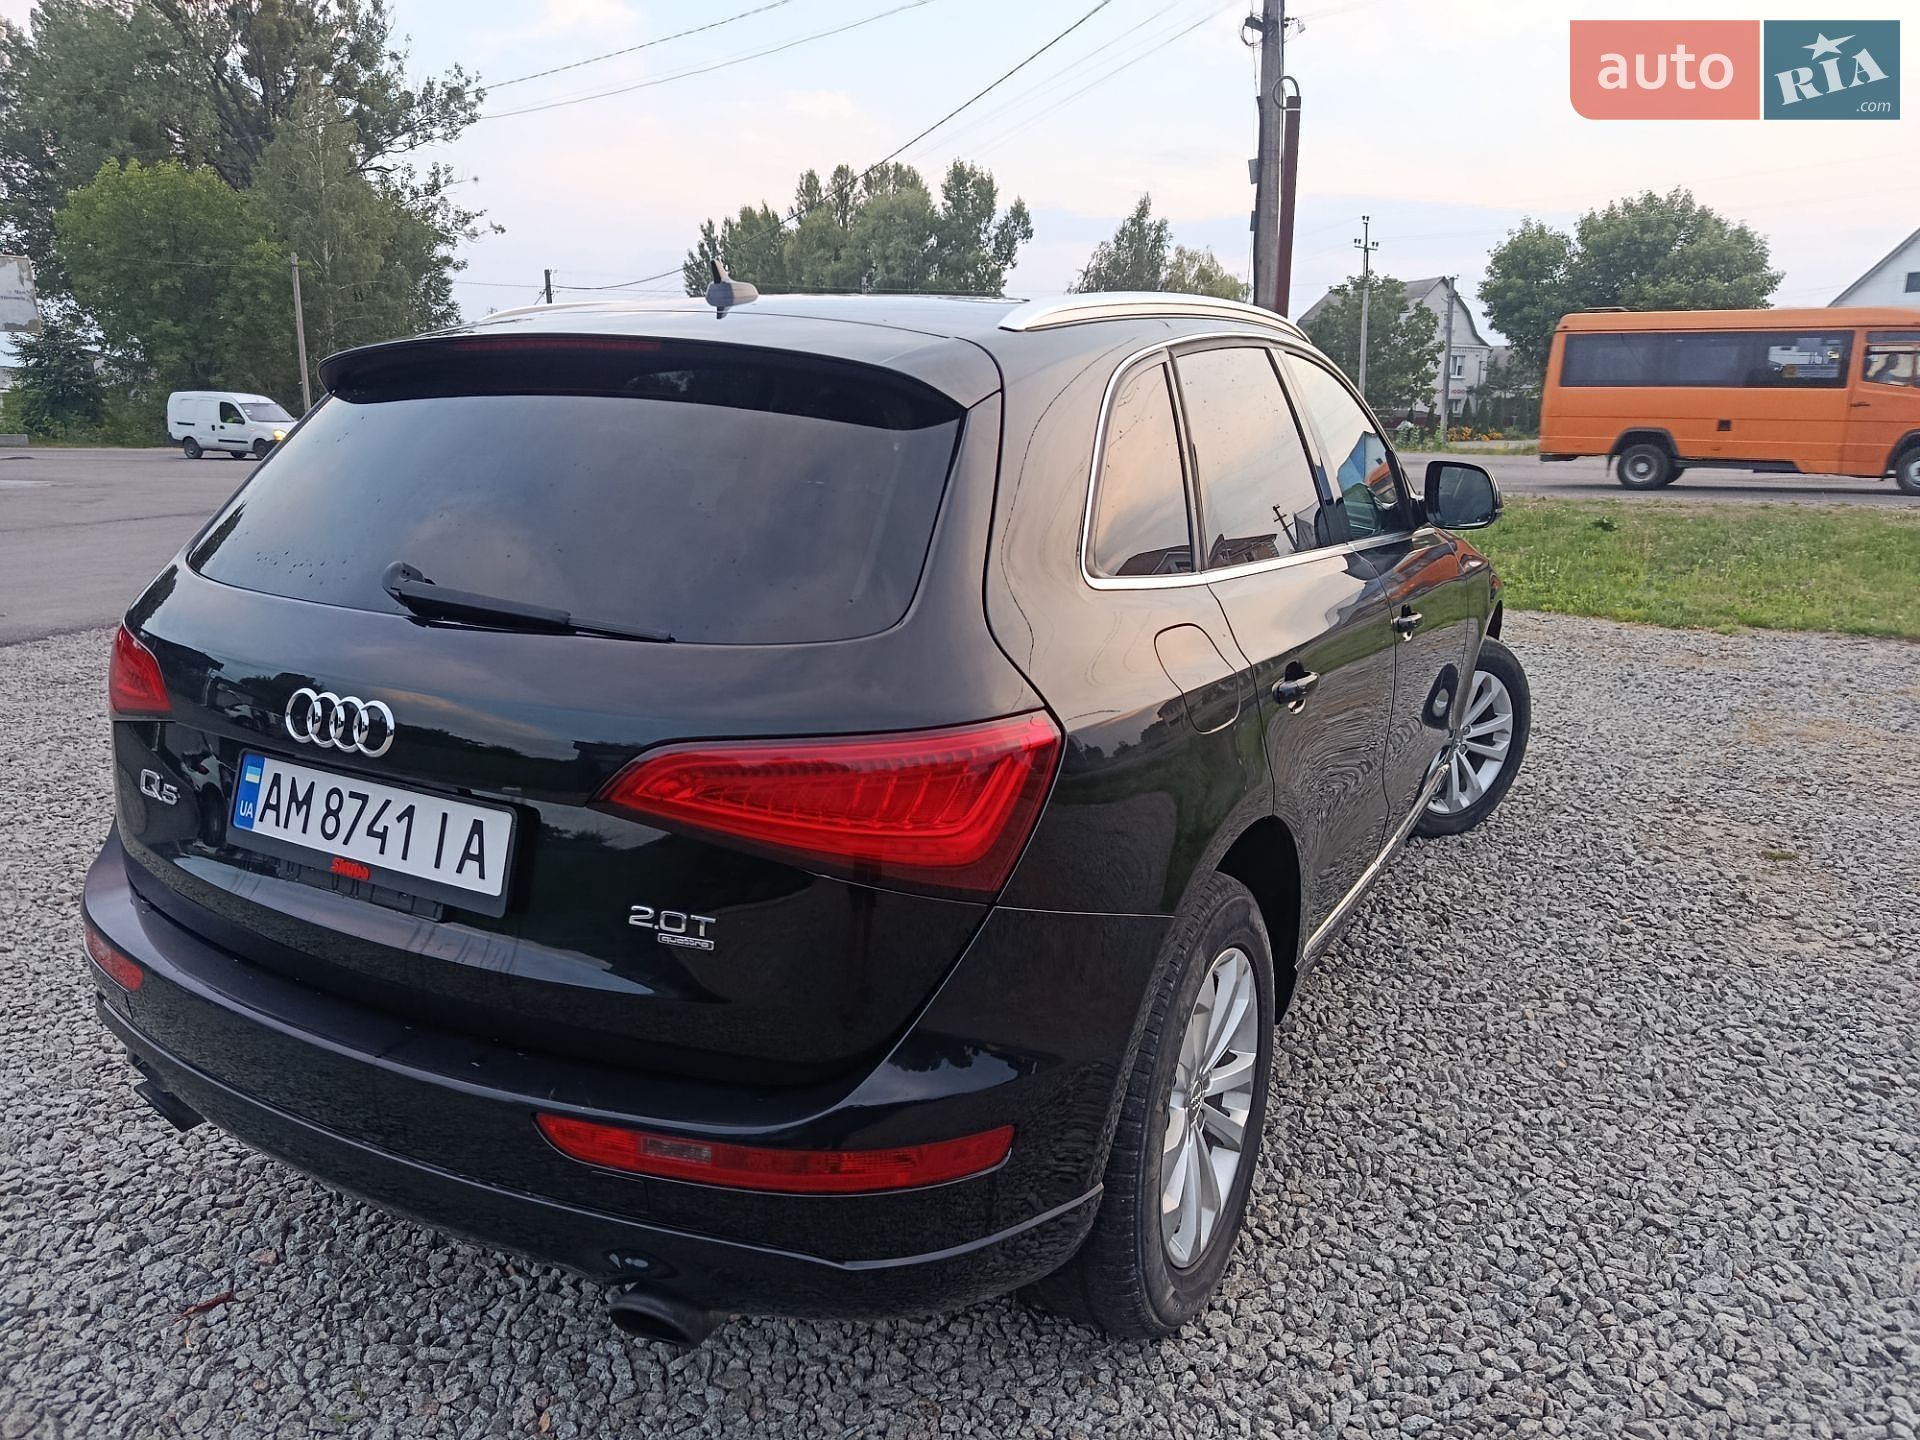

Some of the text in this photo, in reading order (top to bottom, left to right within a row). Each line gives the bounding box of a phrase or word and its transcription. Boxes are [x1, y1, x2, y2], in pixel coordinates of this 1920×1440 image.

[140, 768, 180, 806] Q5
[240, 799, 254, 819] UA
[258, 772, 486, 881] AM 8741 IA
[628, 905, 717, 937] 2.0T
